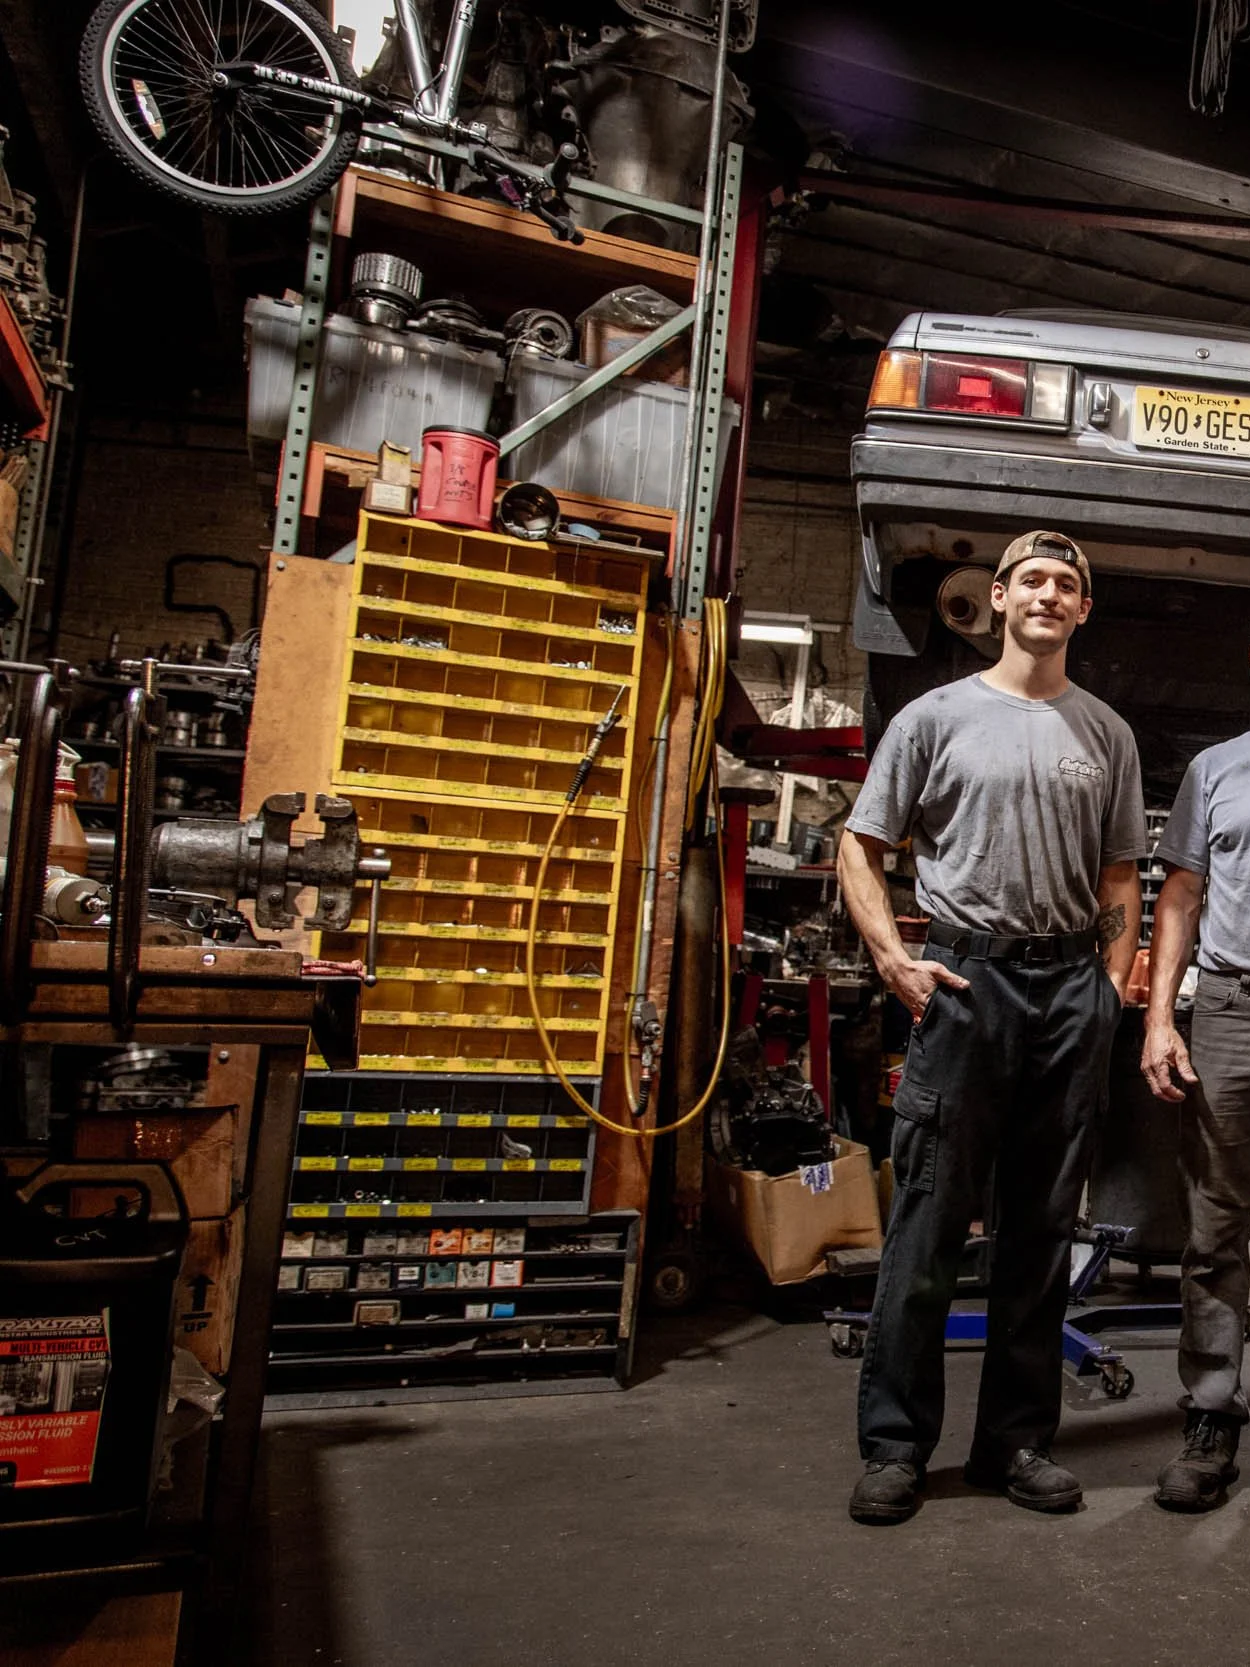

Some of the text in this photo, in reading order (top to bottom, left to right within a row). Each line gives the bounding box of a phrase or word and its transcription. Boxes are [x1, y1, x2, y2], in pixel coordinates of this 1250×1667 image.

[1166, 391, 1230, 409] New Jersey
[1143, 402, 1188, 435] V90
[1164, 436, 1229, 452] Garden State
[0, 1317, 102, 1330] RANSTAR
[184, 1320, 208, 1333] UP
[10, 1339, 107, 1353] MULTI-VEHICLE CVT
[19, 1351, 107, 1362] TRANSMISSION FLUID
[0, 1415, 88, 1430] SLY VARIABLE
[0, 1427, 72, 1442] SSION FLUID
[0, 1446, 39, 1456] nthetic
